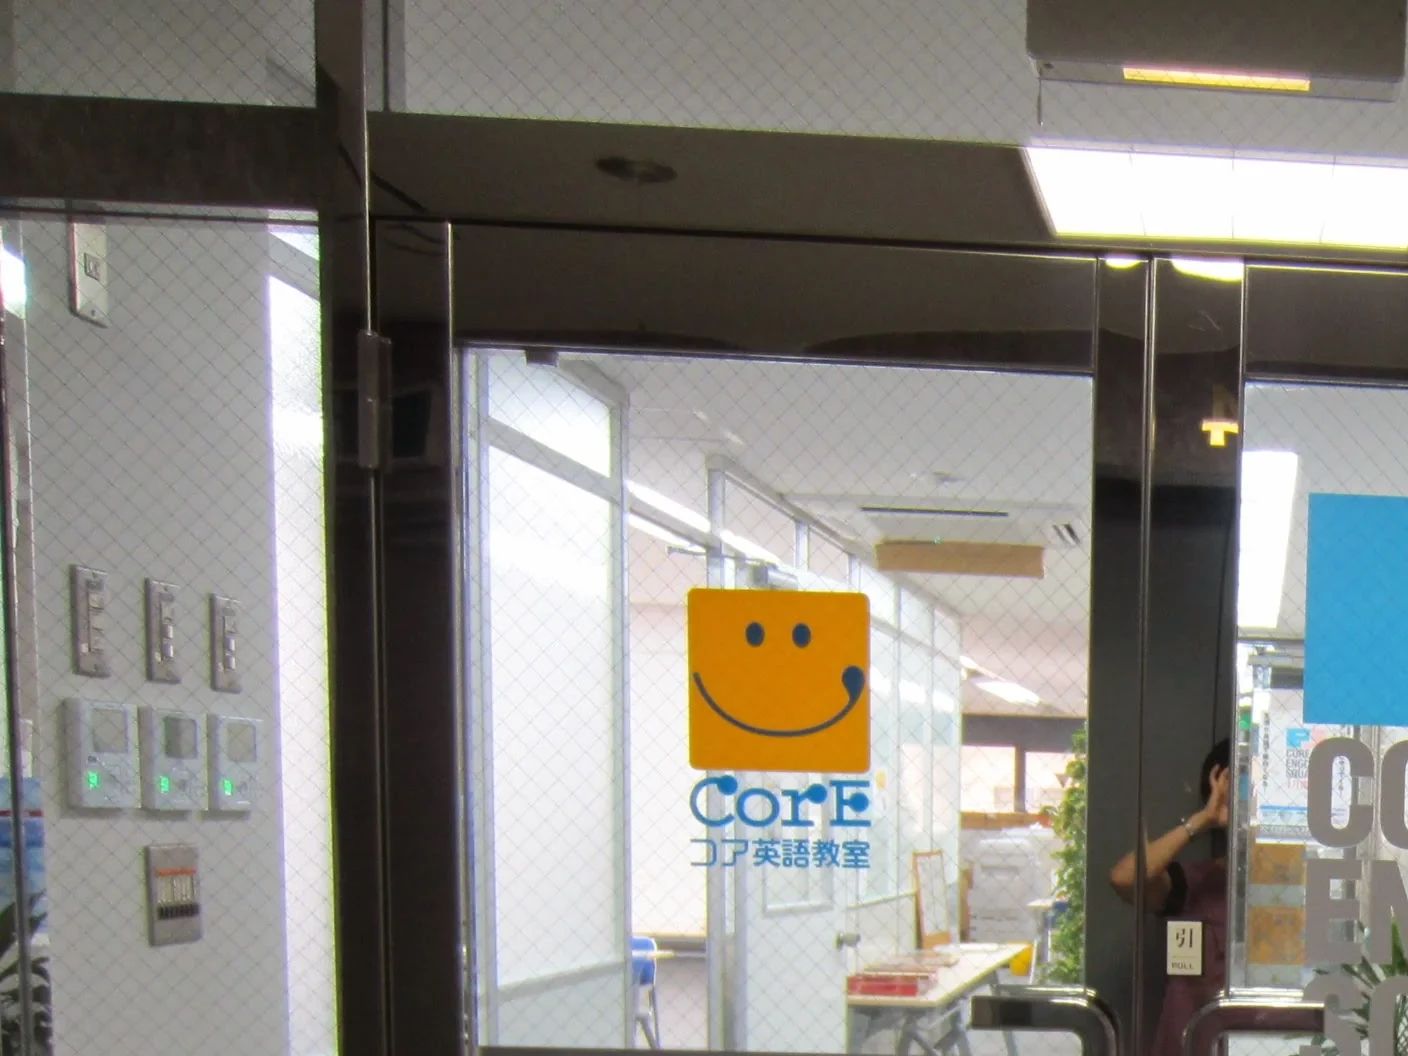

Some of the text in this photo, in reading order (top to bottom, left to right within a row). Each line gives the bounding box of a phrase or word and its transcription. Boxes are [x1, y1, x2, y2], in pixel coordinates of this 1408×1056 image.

[690, 839, 870, 868] コア英語教室
